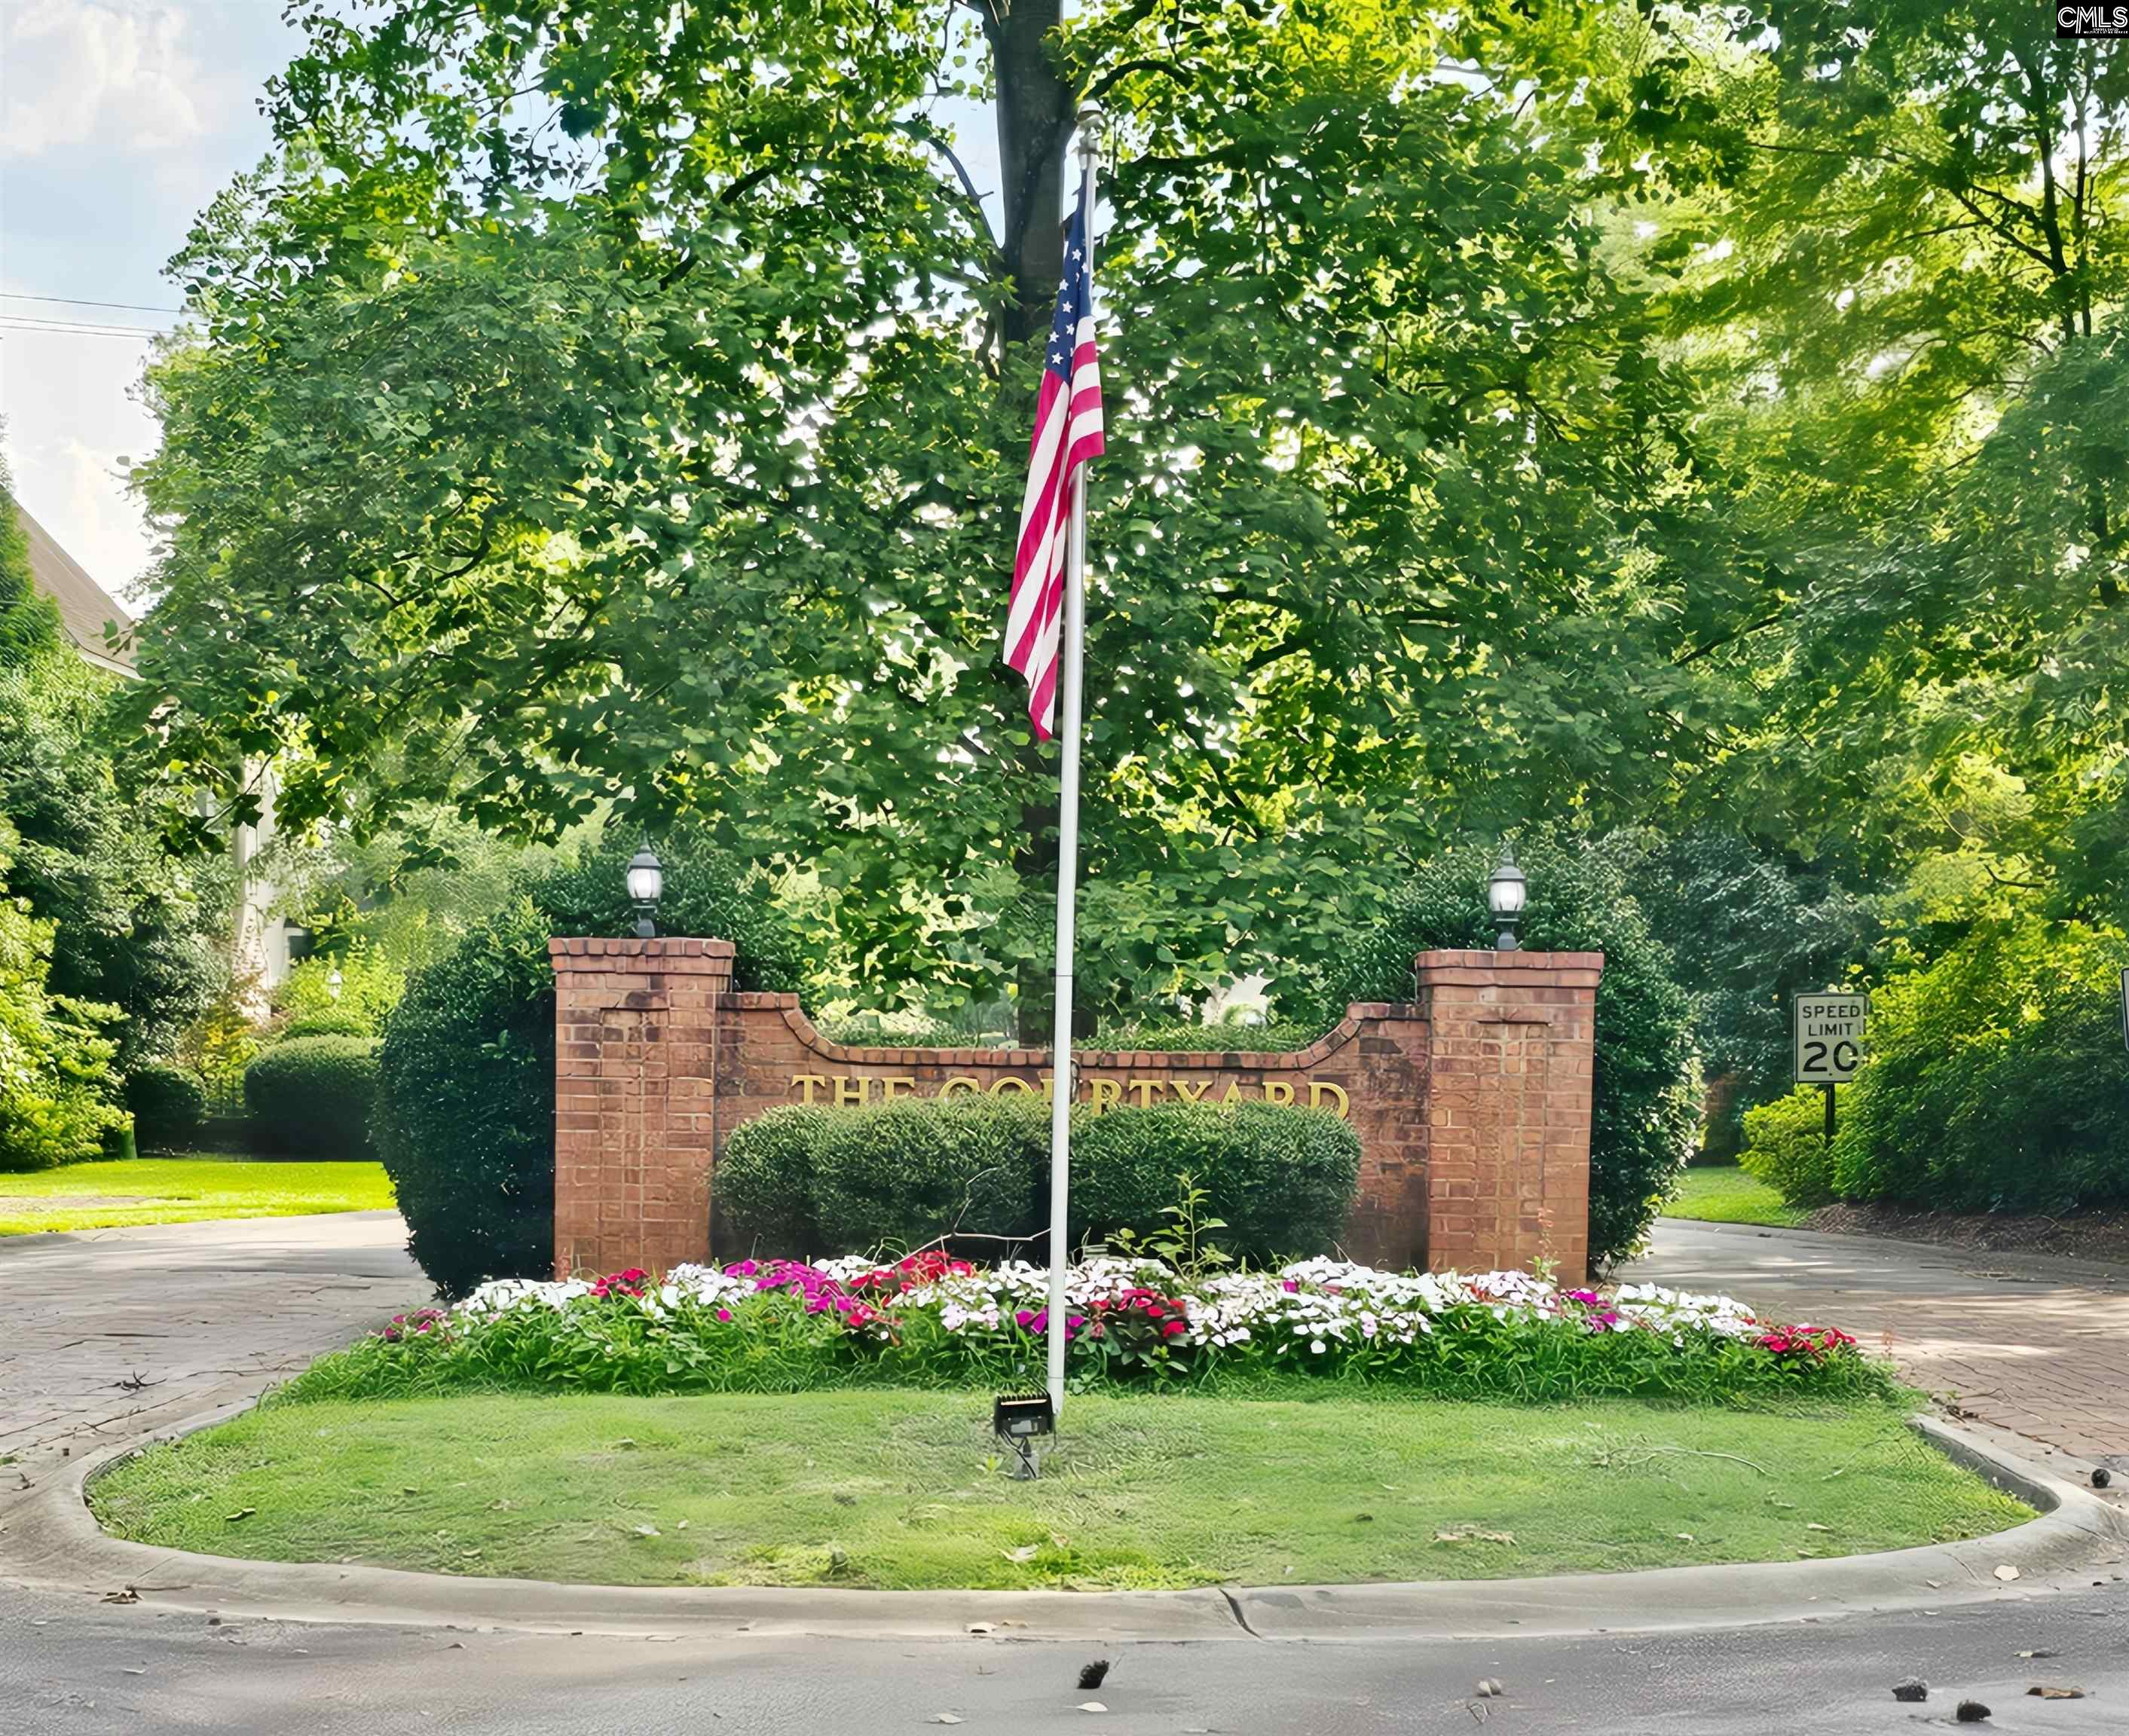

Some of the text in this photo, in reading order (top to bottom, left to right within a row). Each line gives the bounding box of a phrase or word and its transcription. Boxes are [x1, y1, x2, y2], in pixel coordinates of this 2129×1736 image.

[1803, 1005, 1860, 1019] SPEED
[1809, 1023, 1852, 1036] LIMIT
[1803, 1041, 1858, 1072] 20
[791, 1074, 915, 1108] THE
